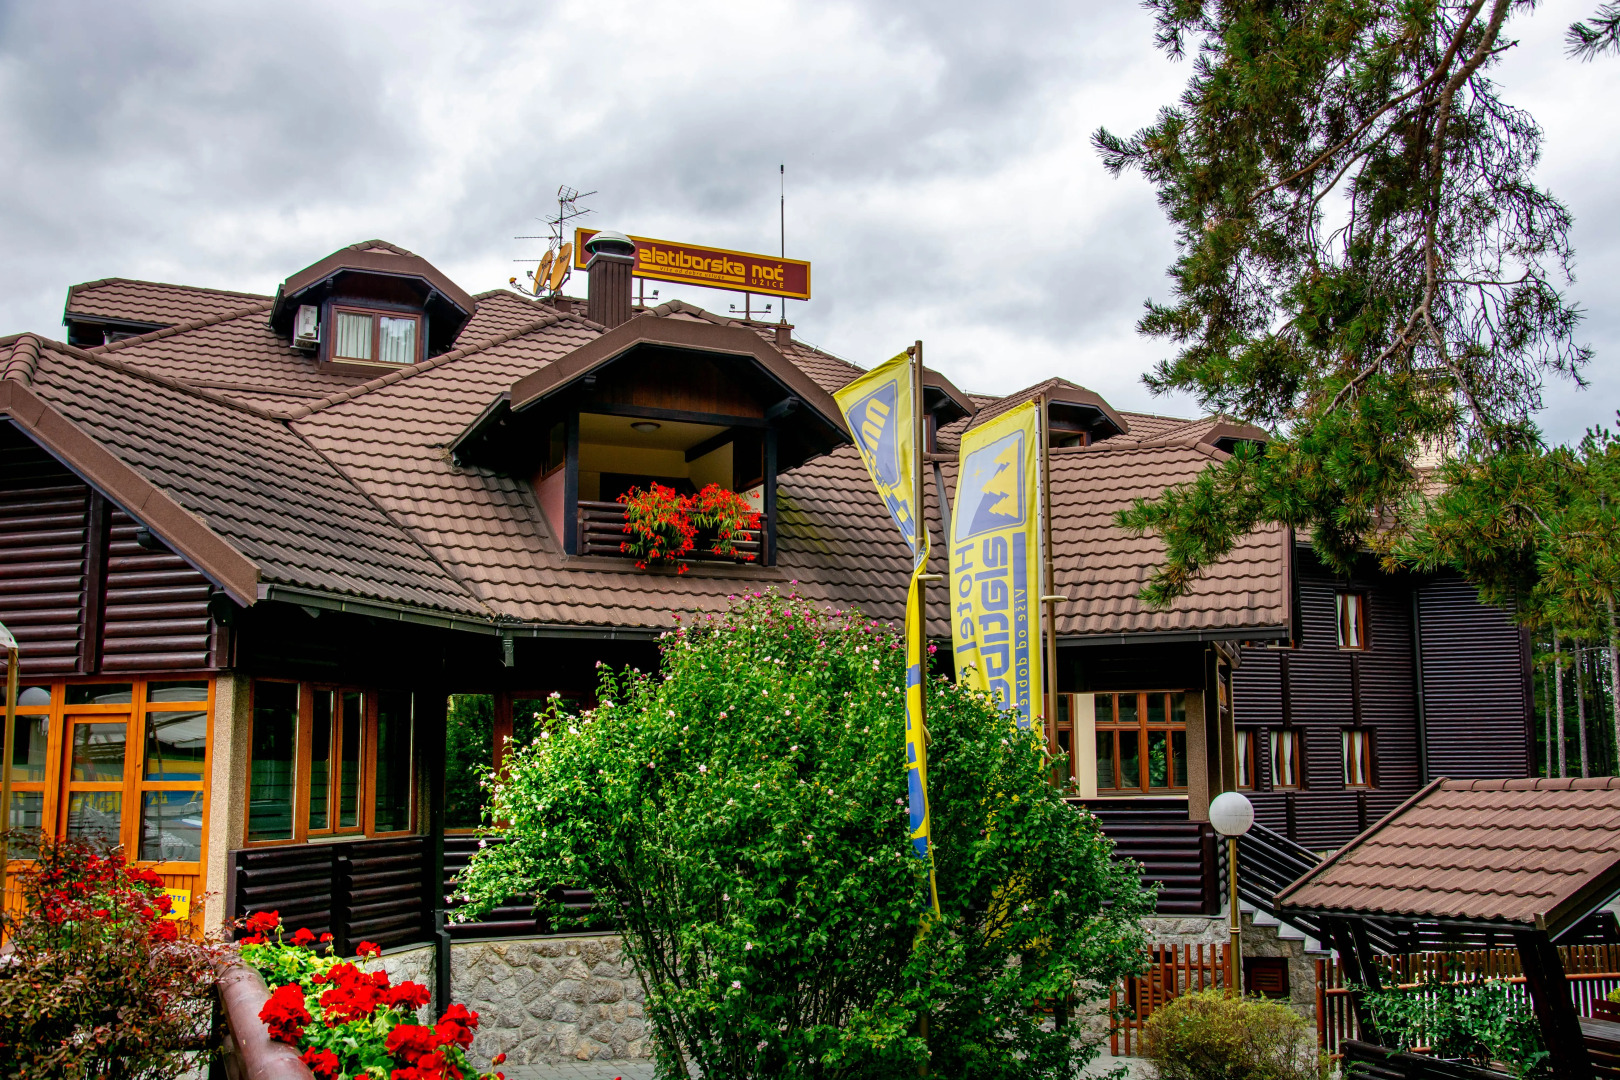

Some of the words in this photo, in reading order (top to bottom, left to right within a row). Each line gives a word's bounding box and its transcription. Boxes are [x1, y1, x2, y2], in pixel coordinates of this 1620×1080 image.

[639, 246, 746, 276] zlatiborska
[751, 264, 784, 281] noć
[751, 278, 784, 289] UŽICE
